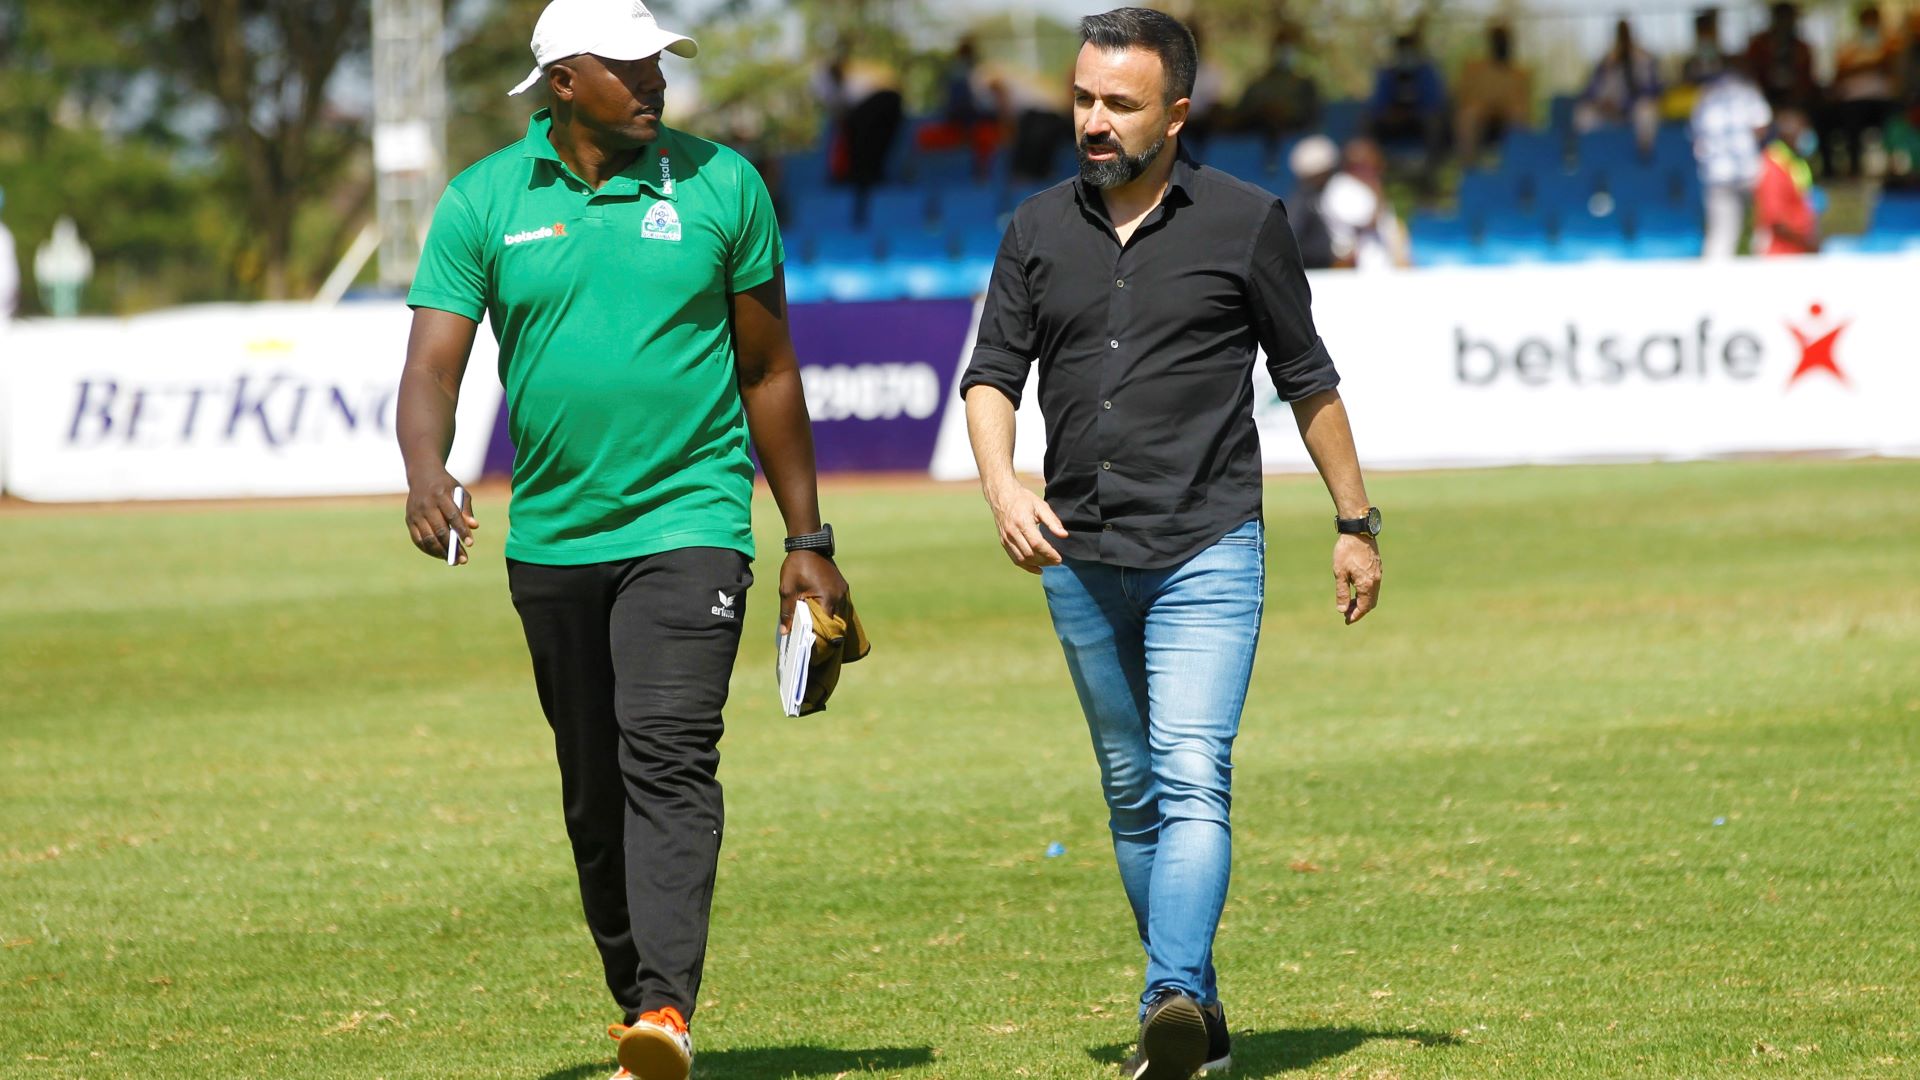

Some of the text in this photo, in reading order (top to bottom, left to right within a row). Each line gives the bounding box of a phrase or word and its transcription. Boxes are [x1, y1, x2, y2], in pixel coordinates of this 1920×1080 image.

[659, 156, 673, 195] betsafe
[504, 226, 553, 246] betsafe
[1454, 315, 1763, 386] betsafe
[711, 605, 735, 619] erima
